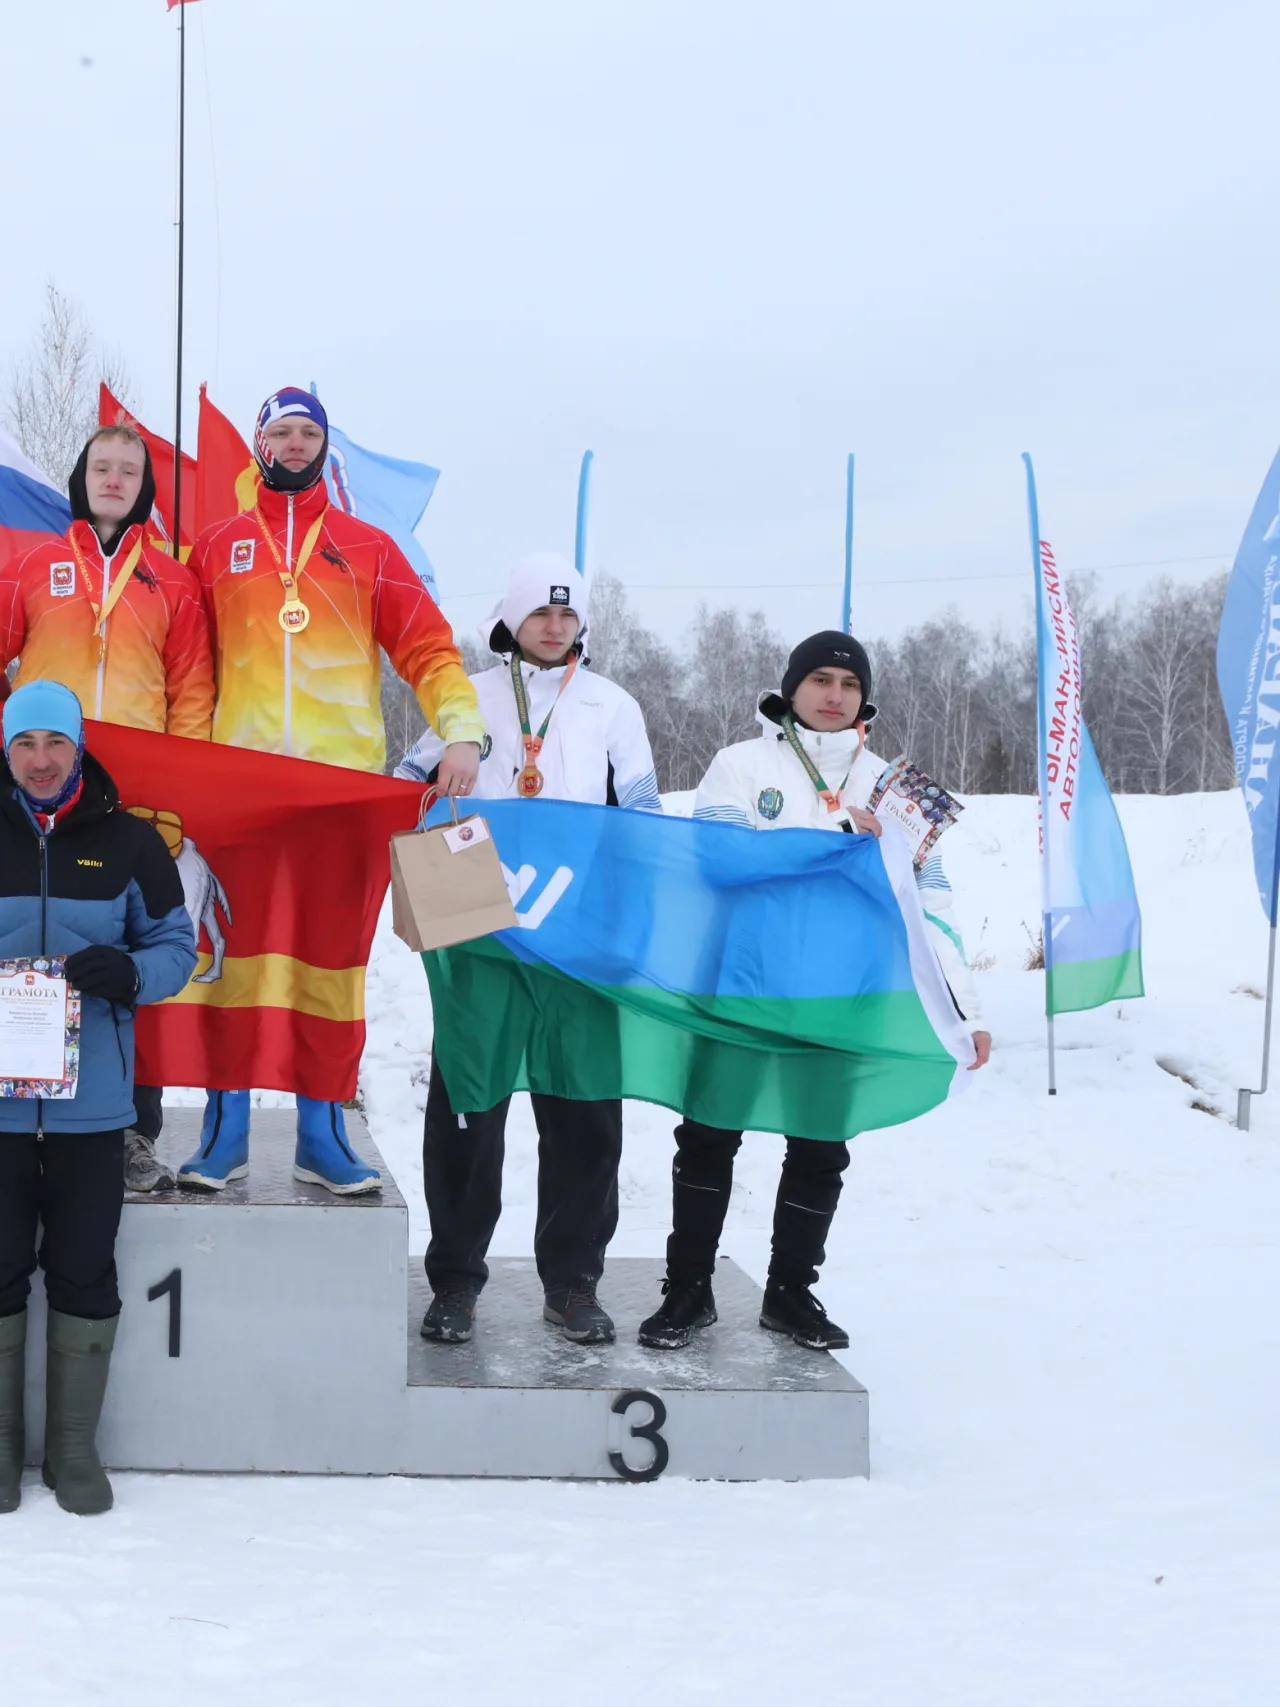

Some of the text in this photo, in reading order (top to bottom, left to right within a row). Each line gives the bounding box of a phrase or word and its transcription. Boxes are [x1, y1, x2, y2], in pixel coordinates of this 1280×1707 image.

[885, 801, 921, 836] ГРАМОТА
[1, 987, 58, 998] ГРАМОТА
[147, 1268, 182, 1358] 1
[608, 1391, 669, 1482] 3
